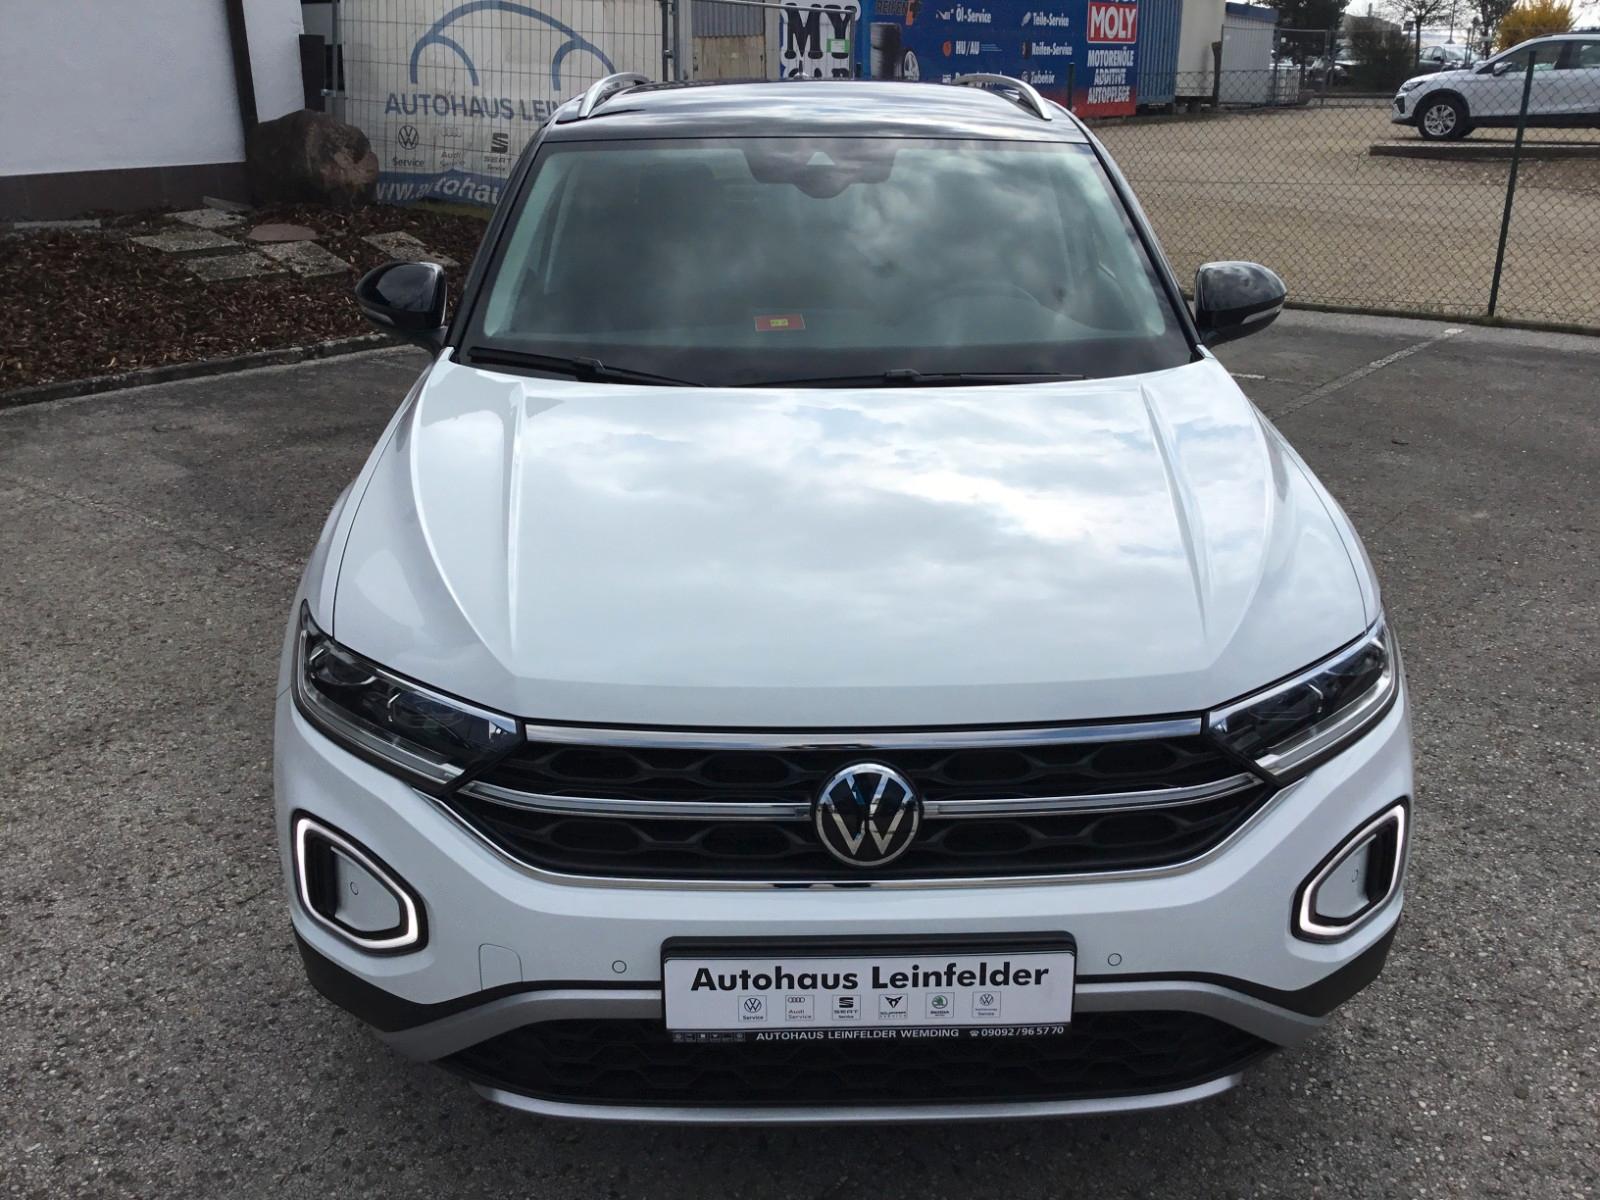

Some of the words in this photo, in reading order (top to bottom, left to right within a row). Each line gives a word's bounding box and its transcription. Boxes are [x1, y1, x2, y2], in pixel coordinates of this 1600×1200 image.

[955, 4, 992, 23] Öl-Service
[1033, 12, 1069, 27] Teile-Service
[1090, 6, 1137, 39] MOLY
[784, 3, 857, 59] MY
[1031, 42, 1073, 56] Reifen-Service
[1087, 46, 1134, 67] MOTORENÖLE
[1030, 70, 1055, 84] Zubehör
[1094, 68, 1127, 85] ADDITIVE
[1087, 86, 1130, 104] AUTOPFLEGE
[384, 93, 514, 121] AUTOHAUS
[392, 157, 425, 168] Service
[691, 966, 858, 991] Autohaus
[872, 962, 1049, 989] Leinfelder
[756, 1031, 824, 1041] AUTOHAUS
[828, 1030, 896, 1039] LEINFELDER
[901, 1028, 960, 1038] WEMDING
